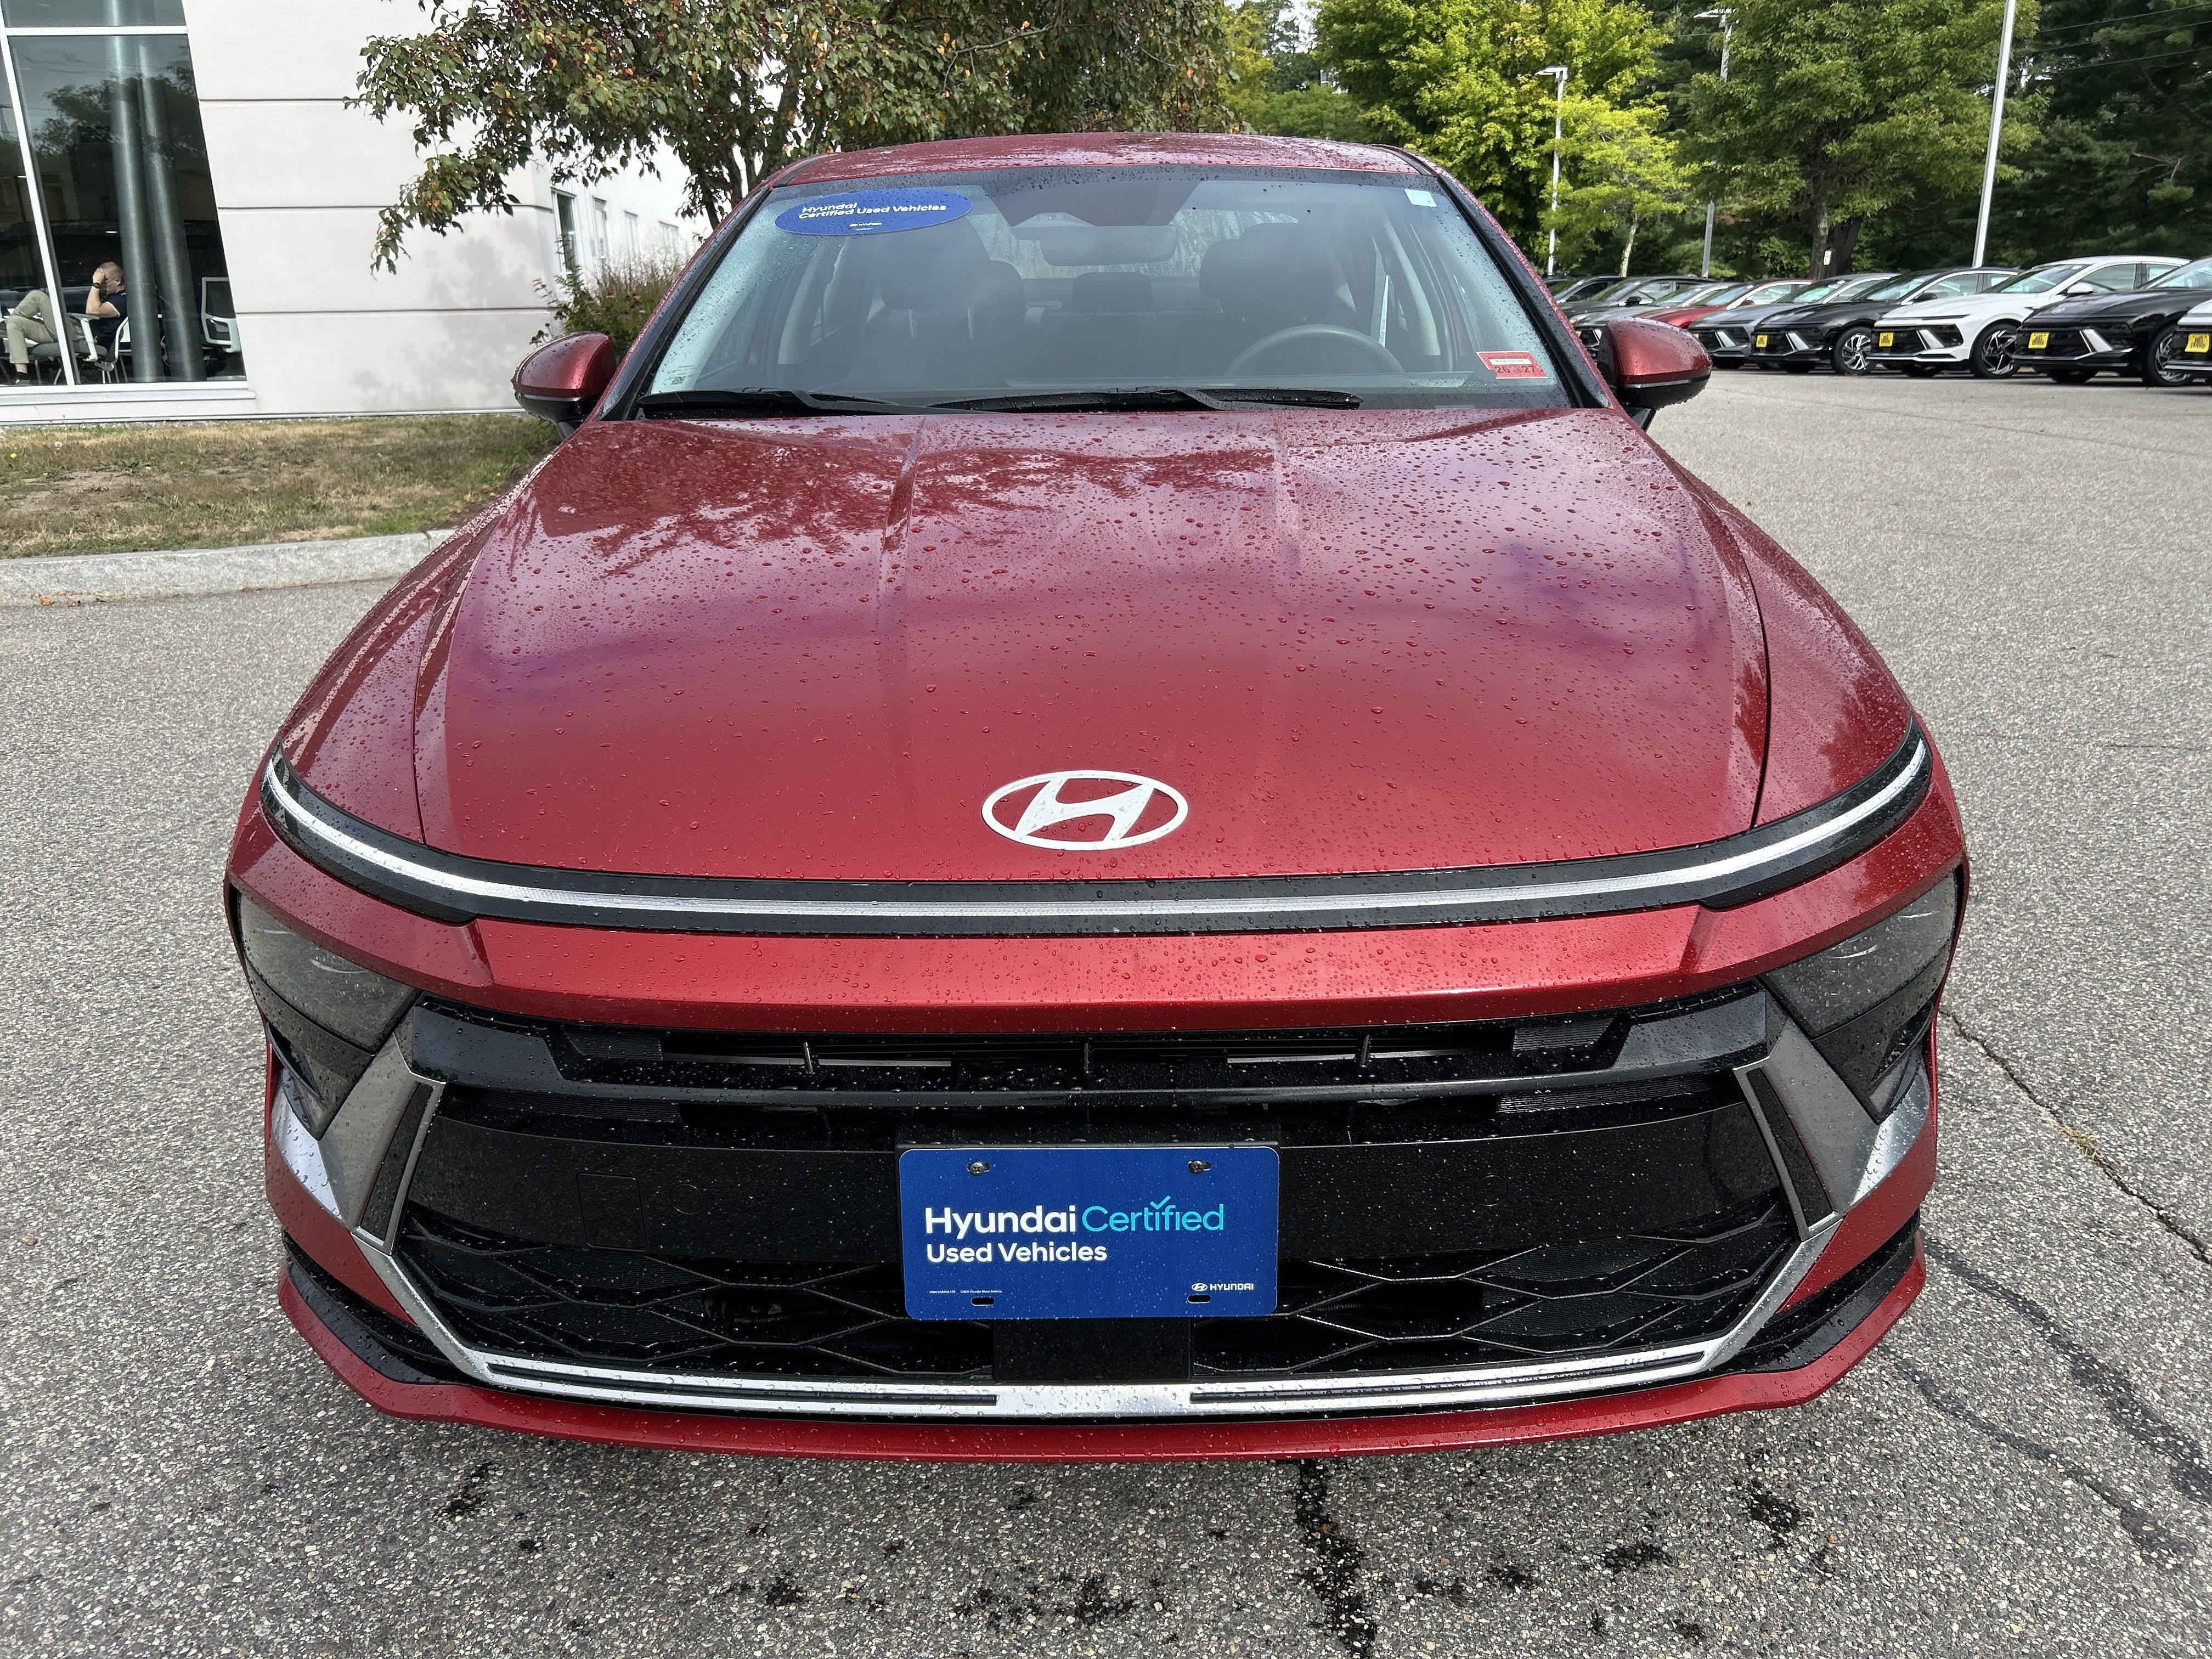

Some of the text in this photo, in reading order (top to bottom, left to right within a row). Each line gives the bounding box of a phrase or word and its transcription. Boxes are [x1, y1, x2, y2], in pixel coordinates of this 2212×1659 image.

[802, 202, 858, 213] Hyundai
[798, 208, 855, 219] Certified
[1494, 365, 1510, 374] 26
[926, 1196, 1224, 1239] Hyundai Certified
[927, 1242, 1107, 1263] Used Vehicles
[1210, 1283, 1254, 1291] HYUNDAI
